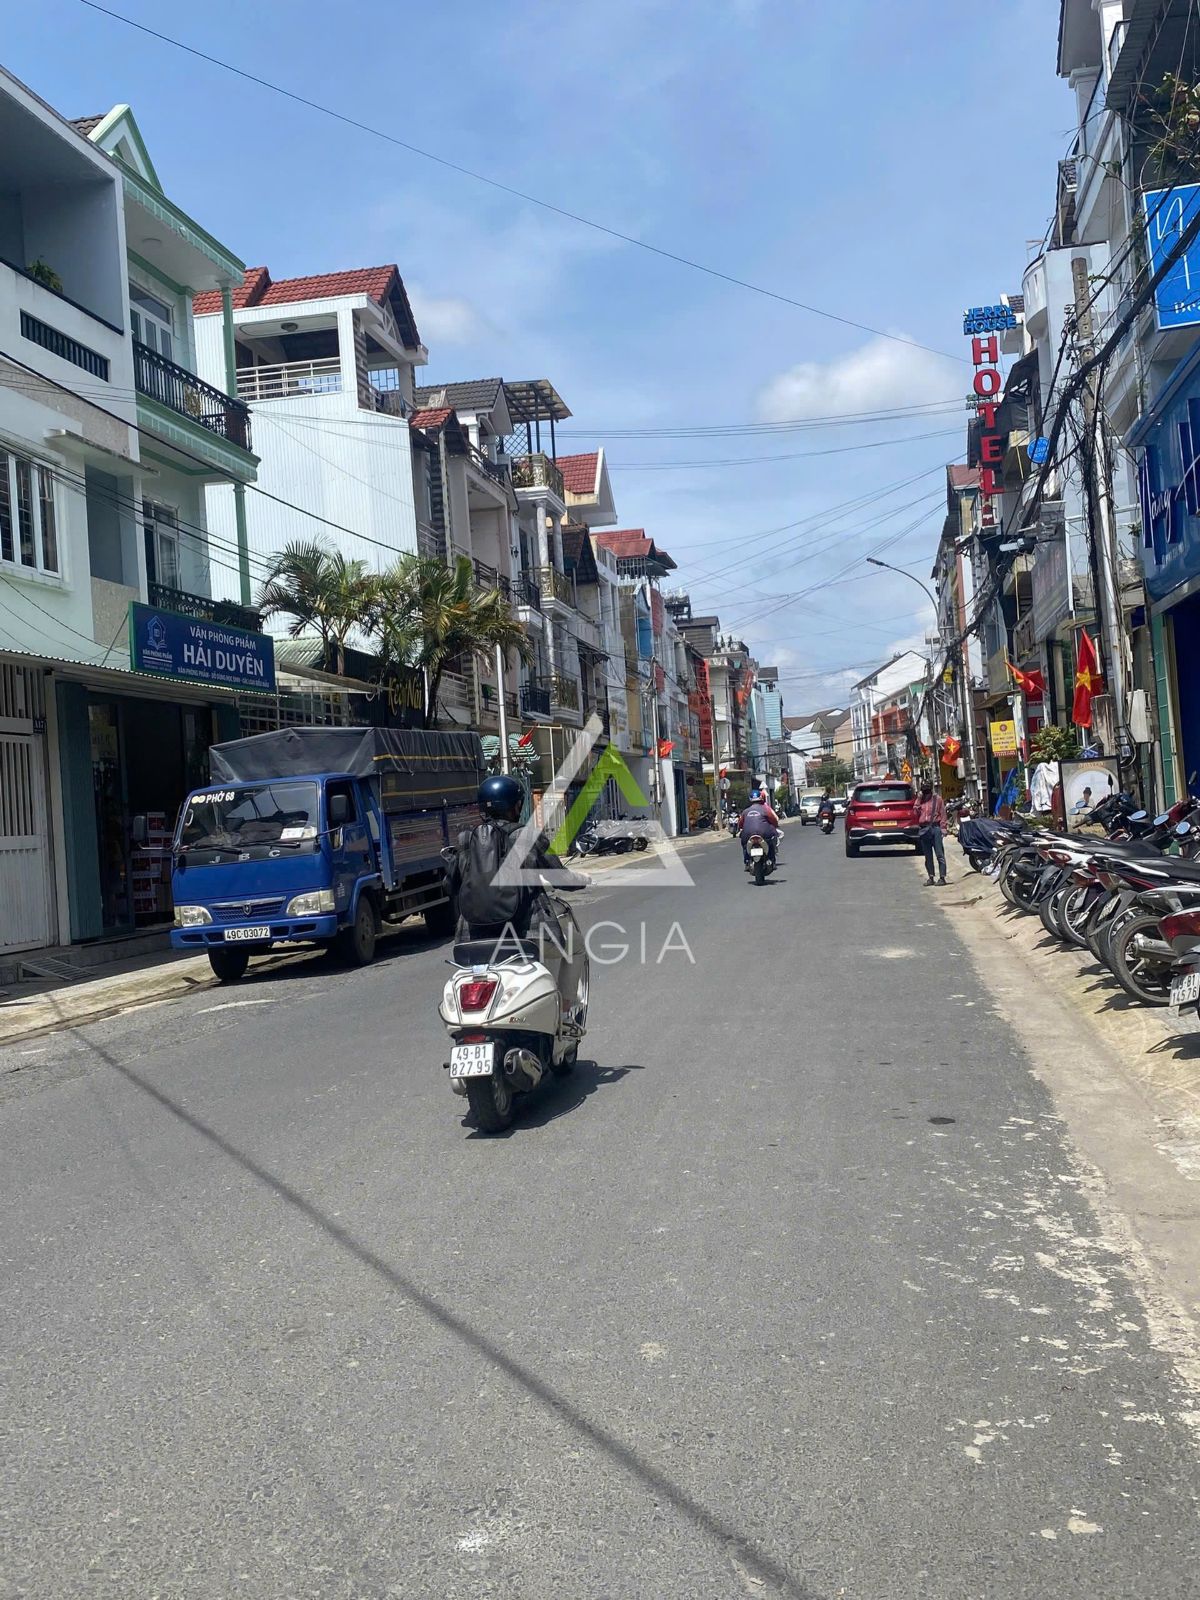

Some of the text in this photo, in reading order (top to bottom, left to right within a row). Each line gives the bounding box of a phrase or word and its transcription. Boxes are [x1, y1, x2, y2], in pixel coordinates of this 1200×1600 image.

[966, 304, 1013, 321] JERRY
[963, 316, 1017, 335] HOUSE
[972, 336, 1005, 495] HOTEL
[208, 630, 234, 647] PHÒNG
[183, 639, 212, 669] HẢI
[215, 650, 263, 677] DUYÊN
[206, 790, 236, 804] PHỞ 68
